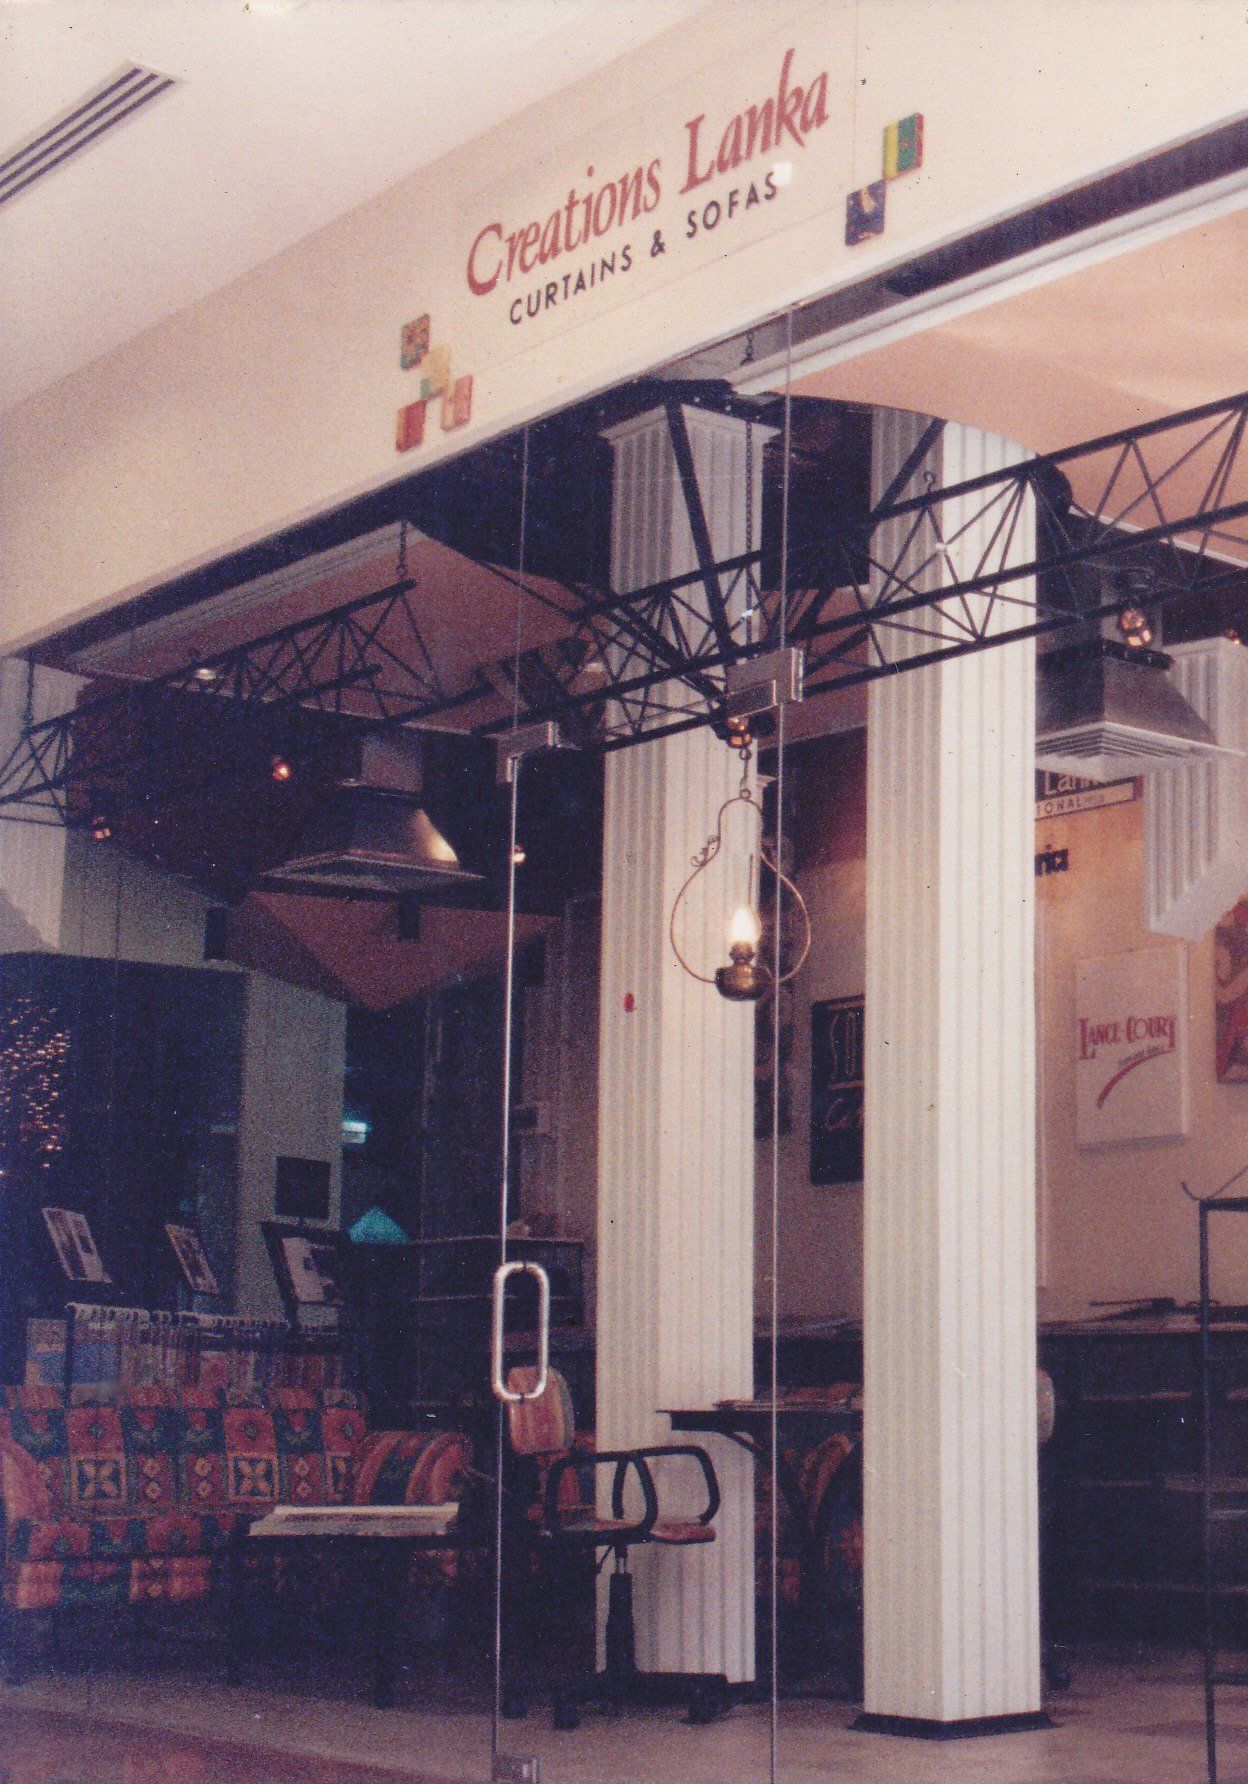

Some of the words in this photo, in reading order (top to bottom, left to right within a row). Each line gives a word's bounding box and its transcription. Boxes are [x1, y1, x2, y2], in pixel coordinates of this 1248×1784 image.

[466, 158, 662, 297] Creations
[679, 47, 830, 194] Lanka
[508, 243, 634, 326] CURTAINS
[650, 229, 667, 256] &
[686, 171, 779, 239] SOFAS
